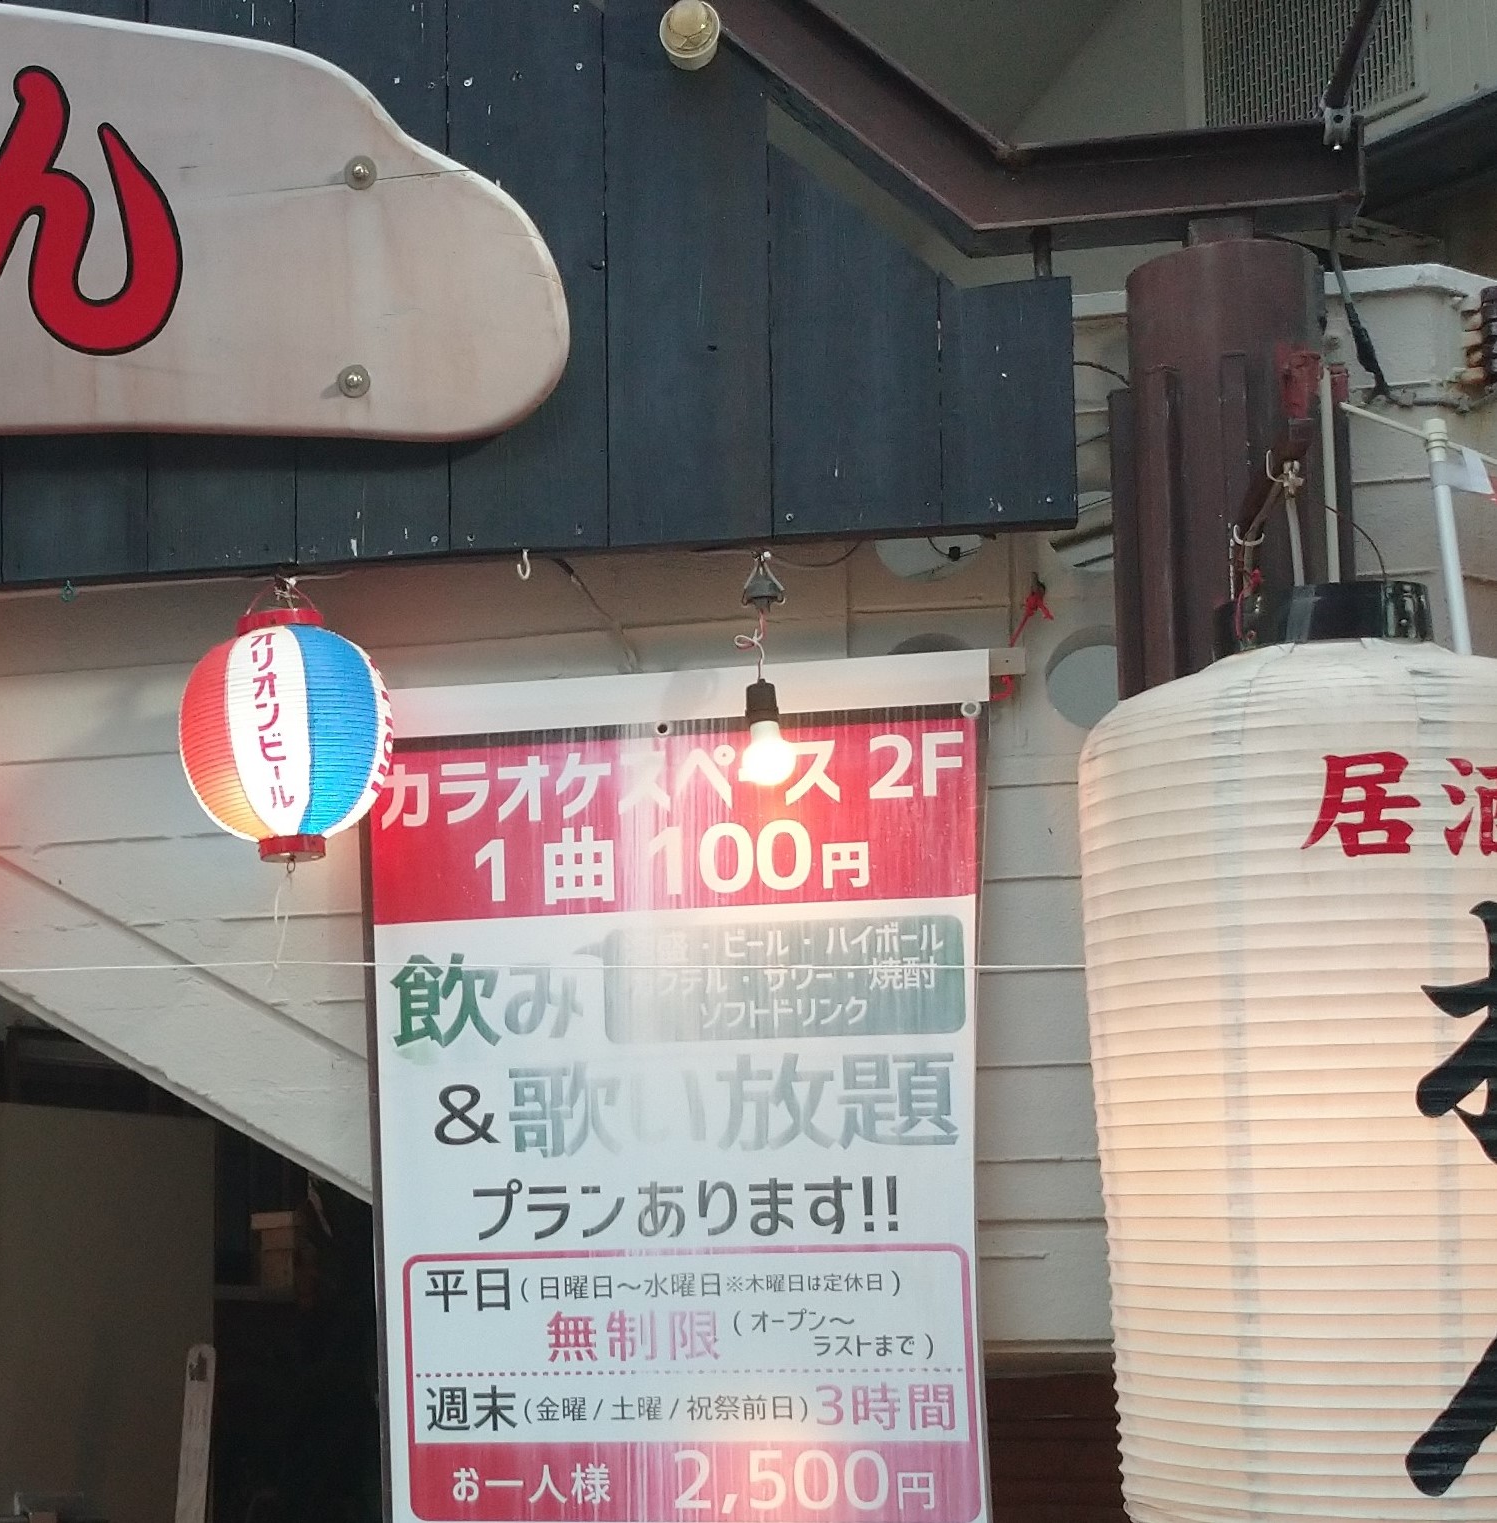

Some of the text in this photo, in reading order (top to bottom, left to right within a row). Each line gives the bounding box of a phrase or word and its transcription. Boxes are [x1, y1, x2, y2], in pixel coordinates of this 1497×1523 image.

[251, 632, 294, 810] オリオンビール
[381, 731, 964, 831] カラオケスペース 2F
[390, 951, 582, 1049] 飲み
[700, 996, 869, 1031] ソフトドリンク
[545, 1310, 720, 1363] 無制限
[451, 1449, 936, 1514] お一人様 2,500円
